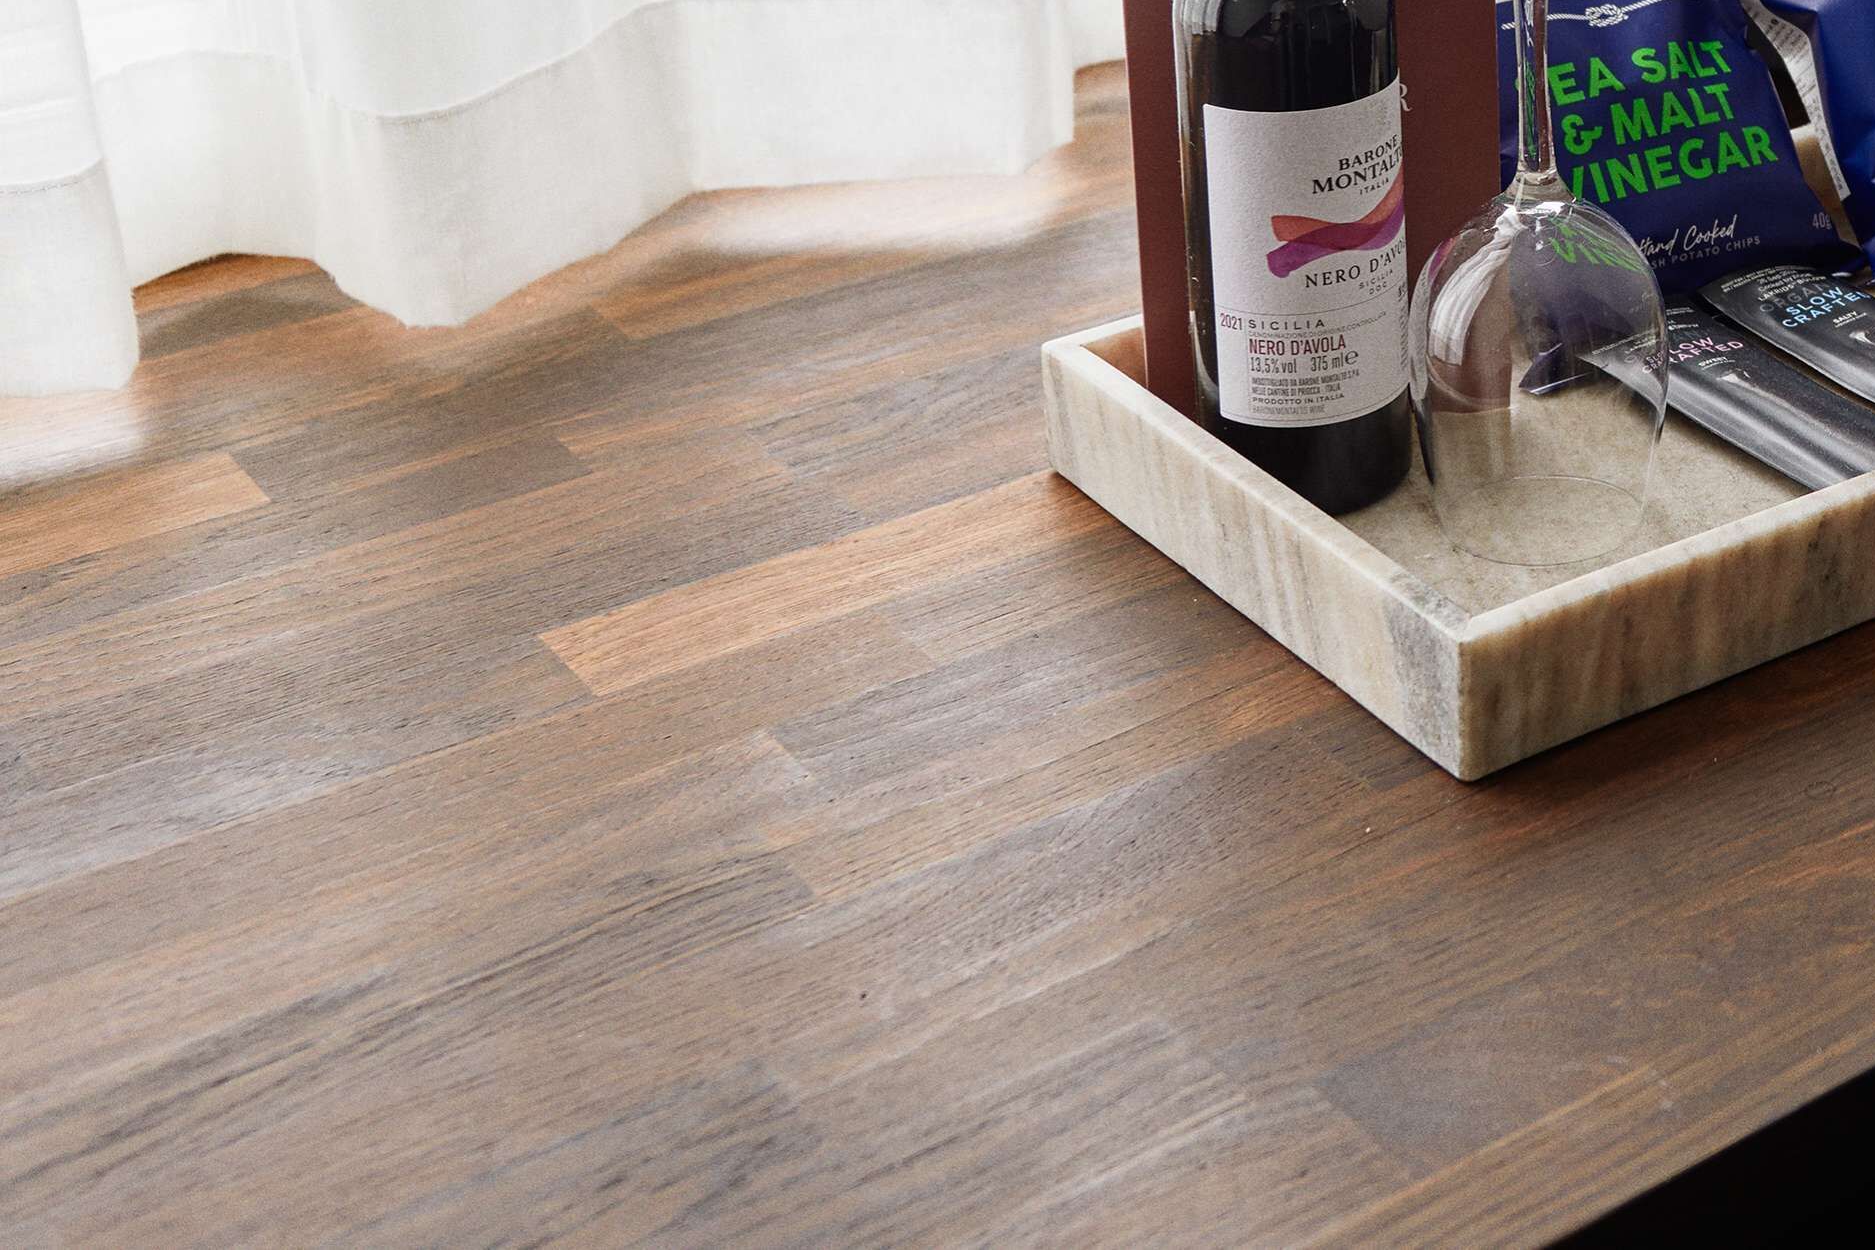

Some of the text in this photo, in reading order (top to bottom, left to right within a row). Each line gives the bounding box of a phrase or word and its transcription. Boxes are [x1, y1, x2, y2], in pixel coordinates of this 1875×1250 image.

[1631, 40, 1732, 83] SALT
[1560, 82, 1734, 156] & MALT
[1338, 134, 1399, 171] BARONE
[1359, 177, 1390, 196] ITALIA
[1638, 228, 1680, 258] Hand
[1683, 214, 1738, 252] Cooked
[1671, 246, 1721, 266] POTATO
[1726, 235, 1761, 252] CHIPS
[1305, 265, 1361, 288] NERO
[1359, 268, 1394, 290] SICILIA
[1369, 281, 1388, 295] DOC
[1785, 286, 1844, 315] SLOW
[1220, 312, 1243, 331] 2021
[1248, 319, 1326, 331] SICILIA
[1832, 311, 1858, 324] SALTY
[1249, 334, 1346, 356] NERO D'AVOLA
[1668, 336, 1714, 355] LOW
[1281, 358, 1298, 374] vol
[1310, 355, 1329, 372] 375
[1252, 396, 1302, 405] PRODOTTO
[1316, 393, 1345, 403] ITALIA
